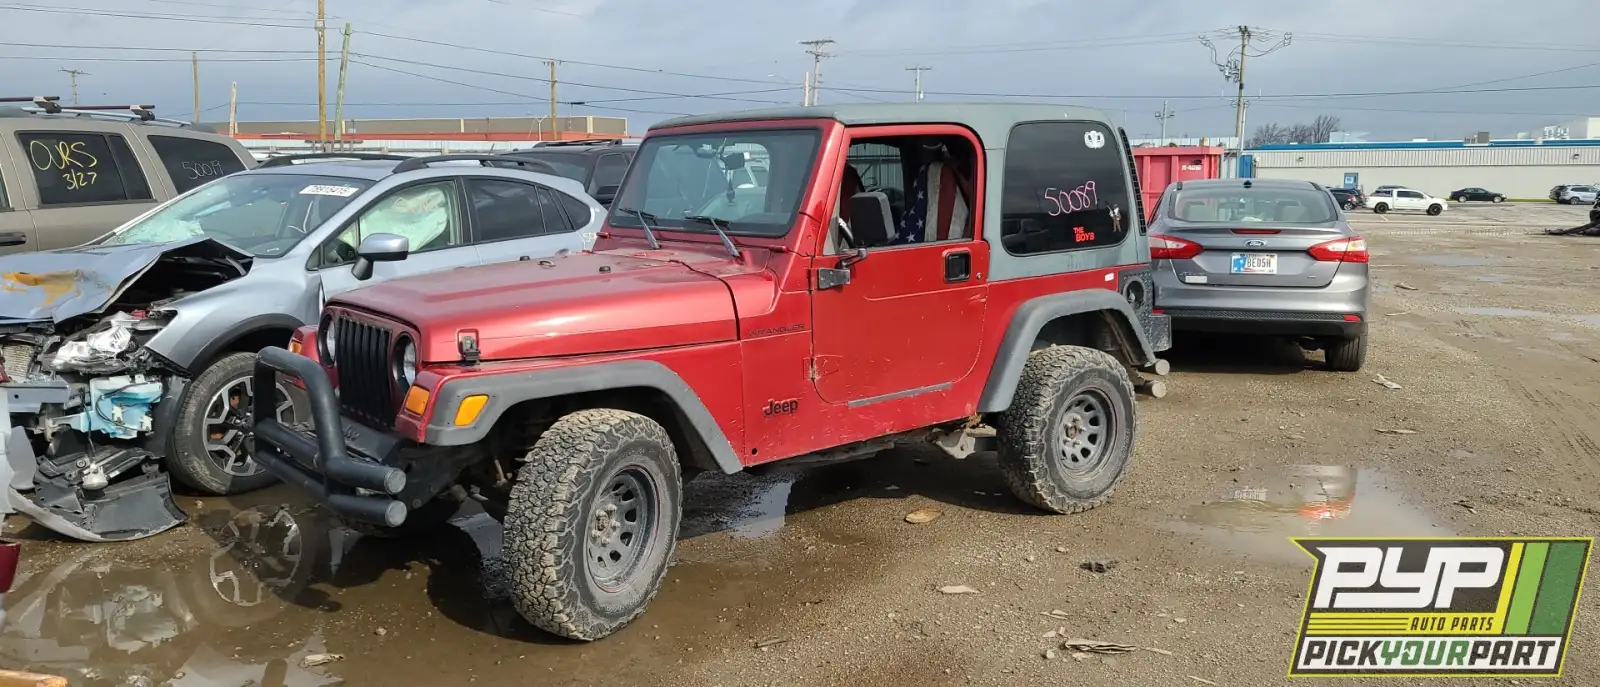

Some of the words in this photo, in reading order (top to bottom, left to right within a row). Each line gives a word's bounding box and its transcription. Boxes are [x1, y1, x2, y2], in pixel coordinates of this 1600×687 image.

[62, 168, 98, 190] 3/27
[1044, 180, 1098, 216] 50089
[1073, 226, 1085, 234] THE
[1075, 232, 1095, 242] BOYS
[748, 323, 805, 337] WRANGLER
[763, 398, 798, 416] Jeep
